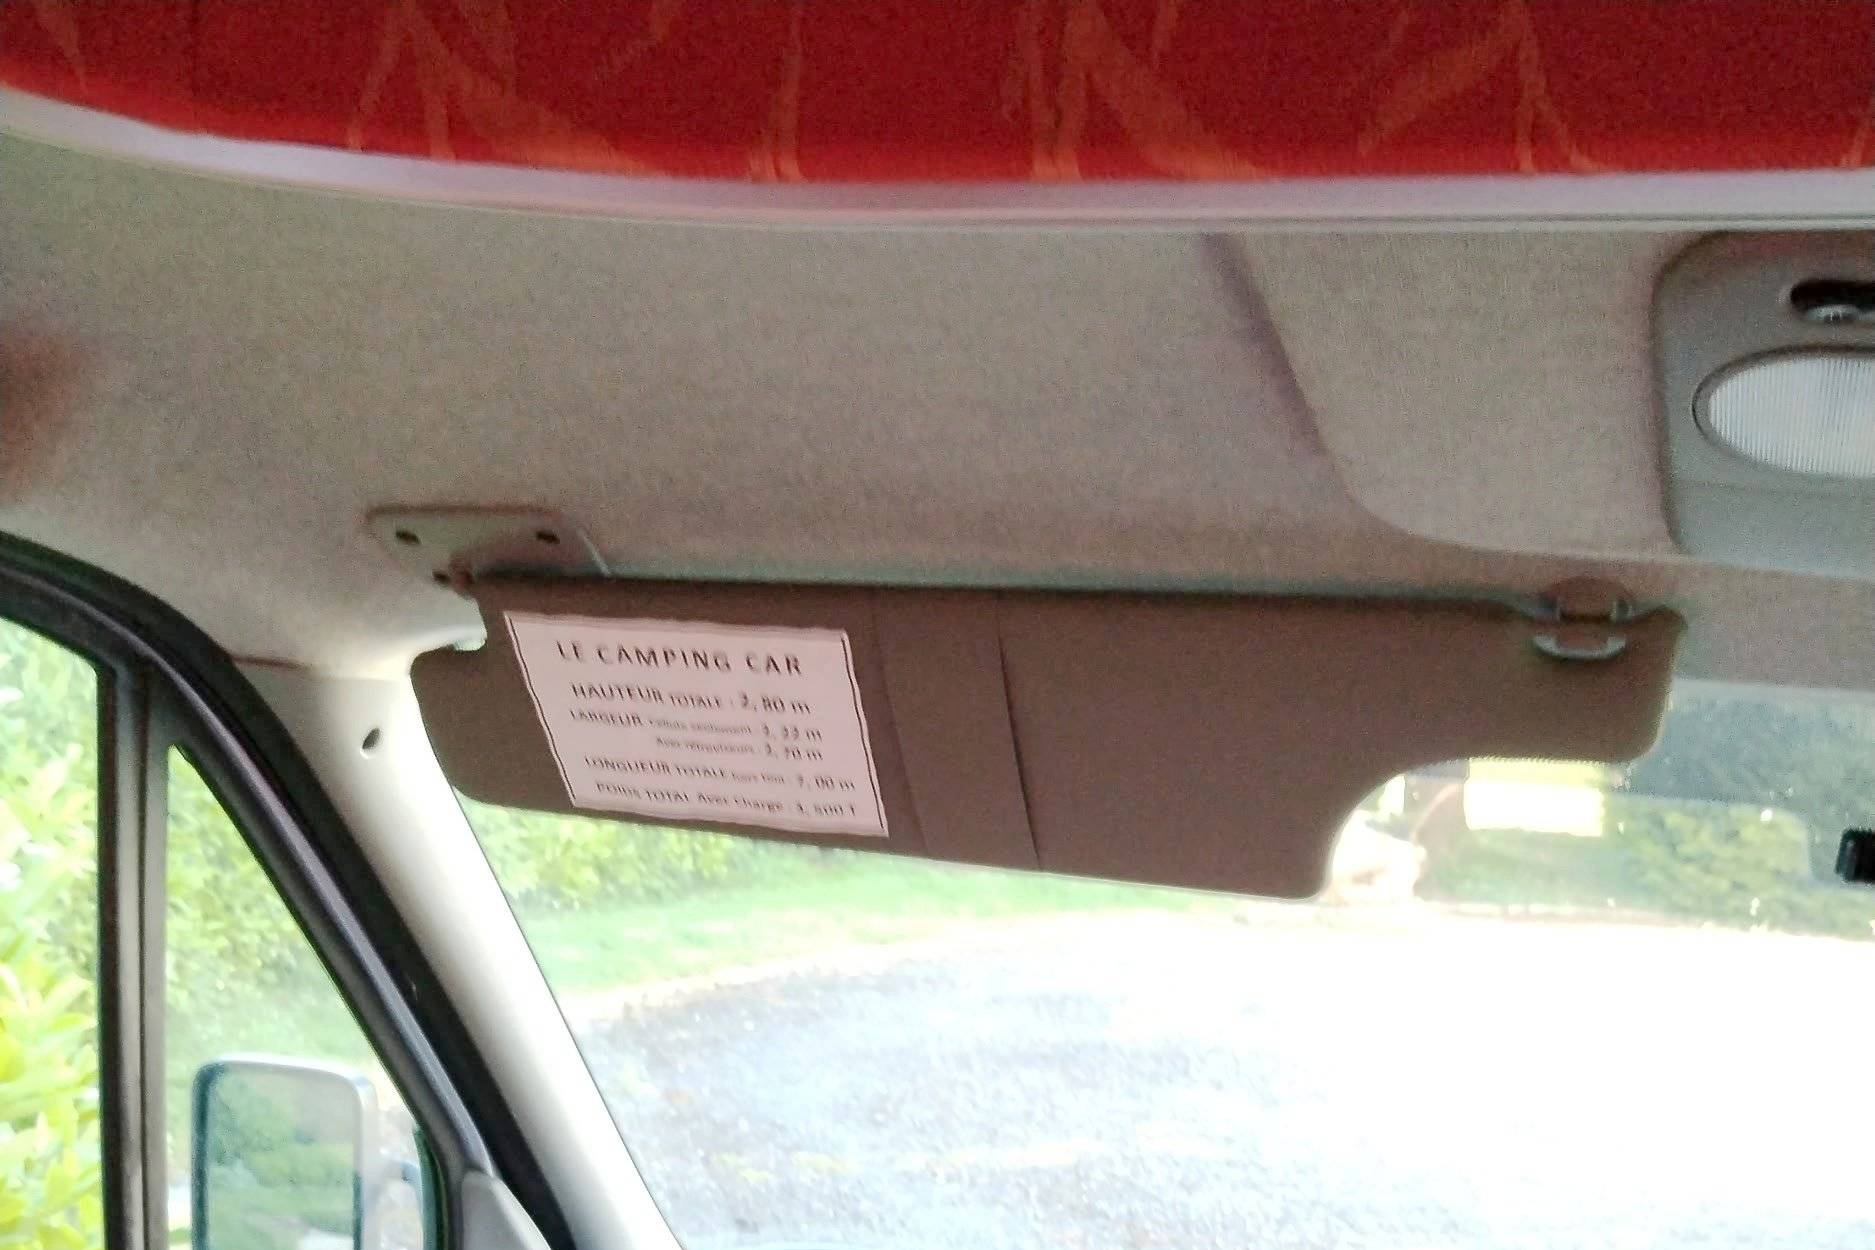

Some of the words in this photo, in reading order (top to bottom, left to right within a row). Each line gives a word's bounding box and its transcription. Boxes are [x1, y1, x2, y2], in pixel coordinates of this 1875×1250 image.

[595, 644, 732, 673] CAMPING
[744, 651, 802, 676] CAR
[570, 682, 664, 704] HAUTEUR
